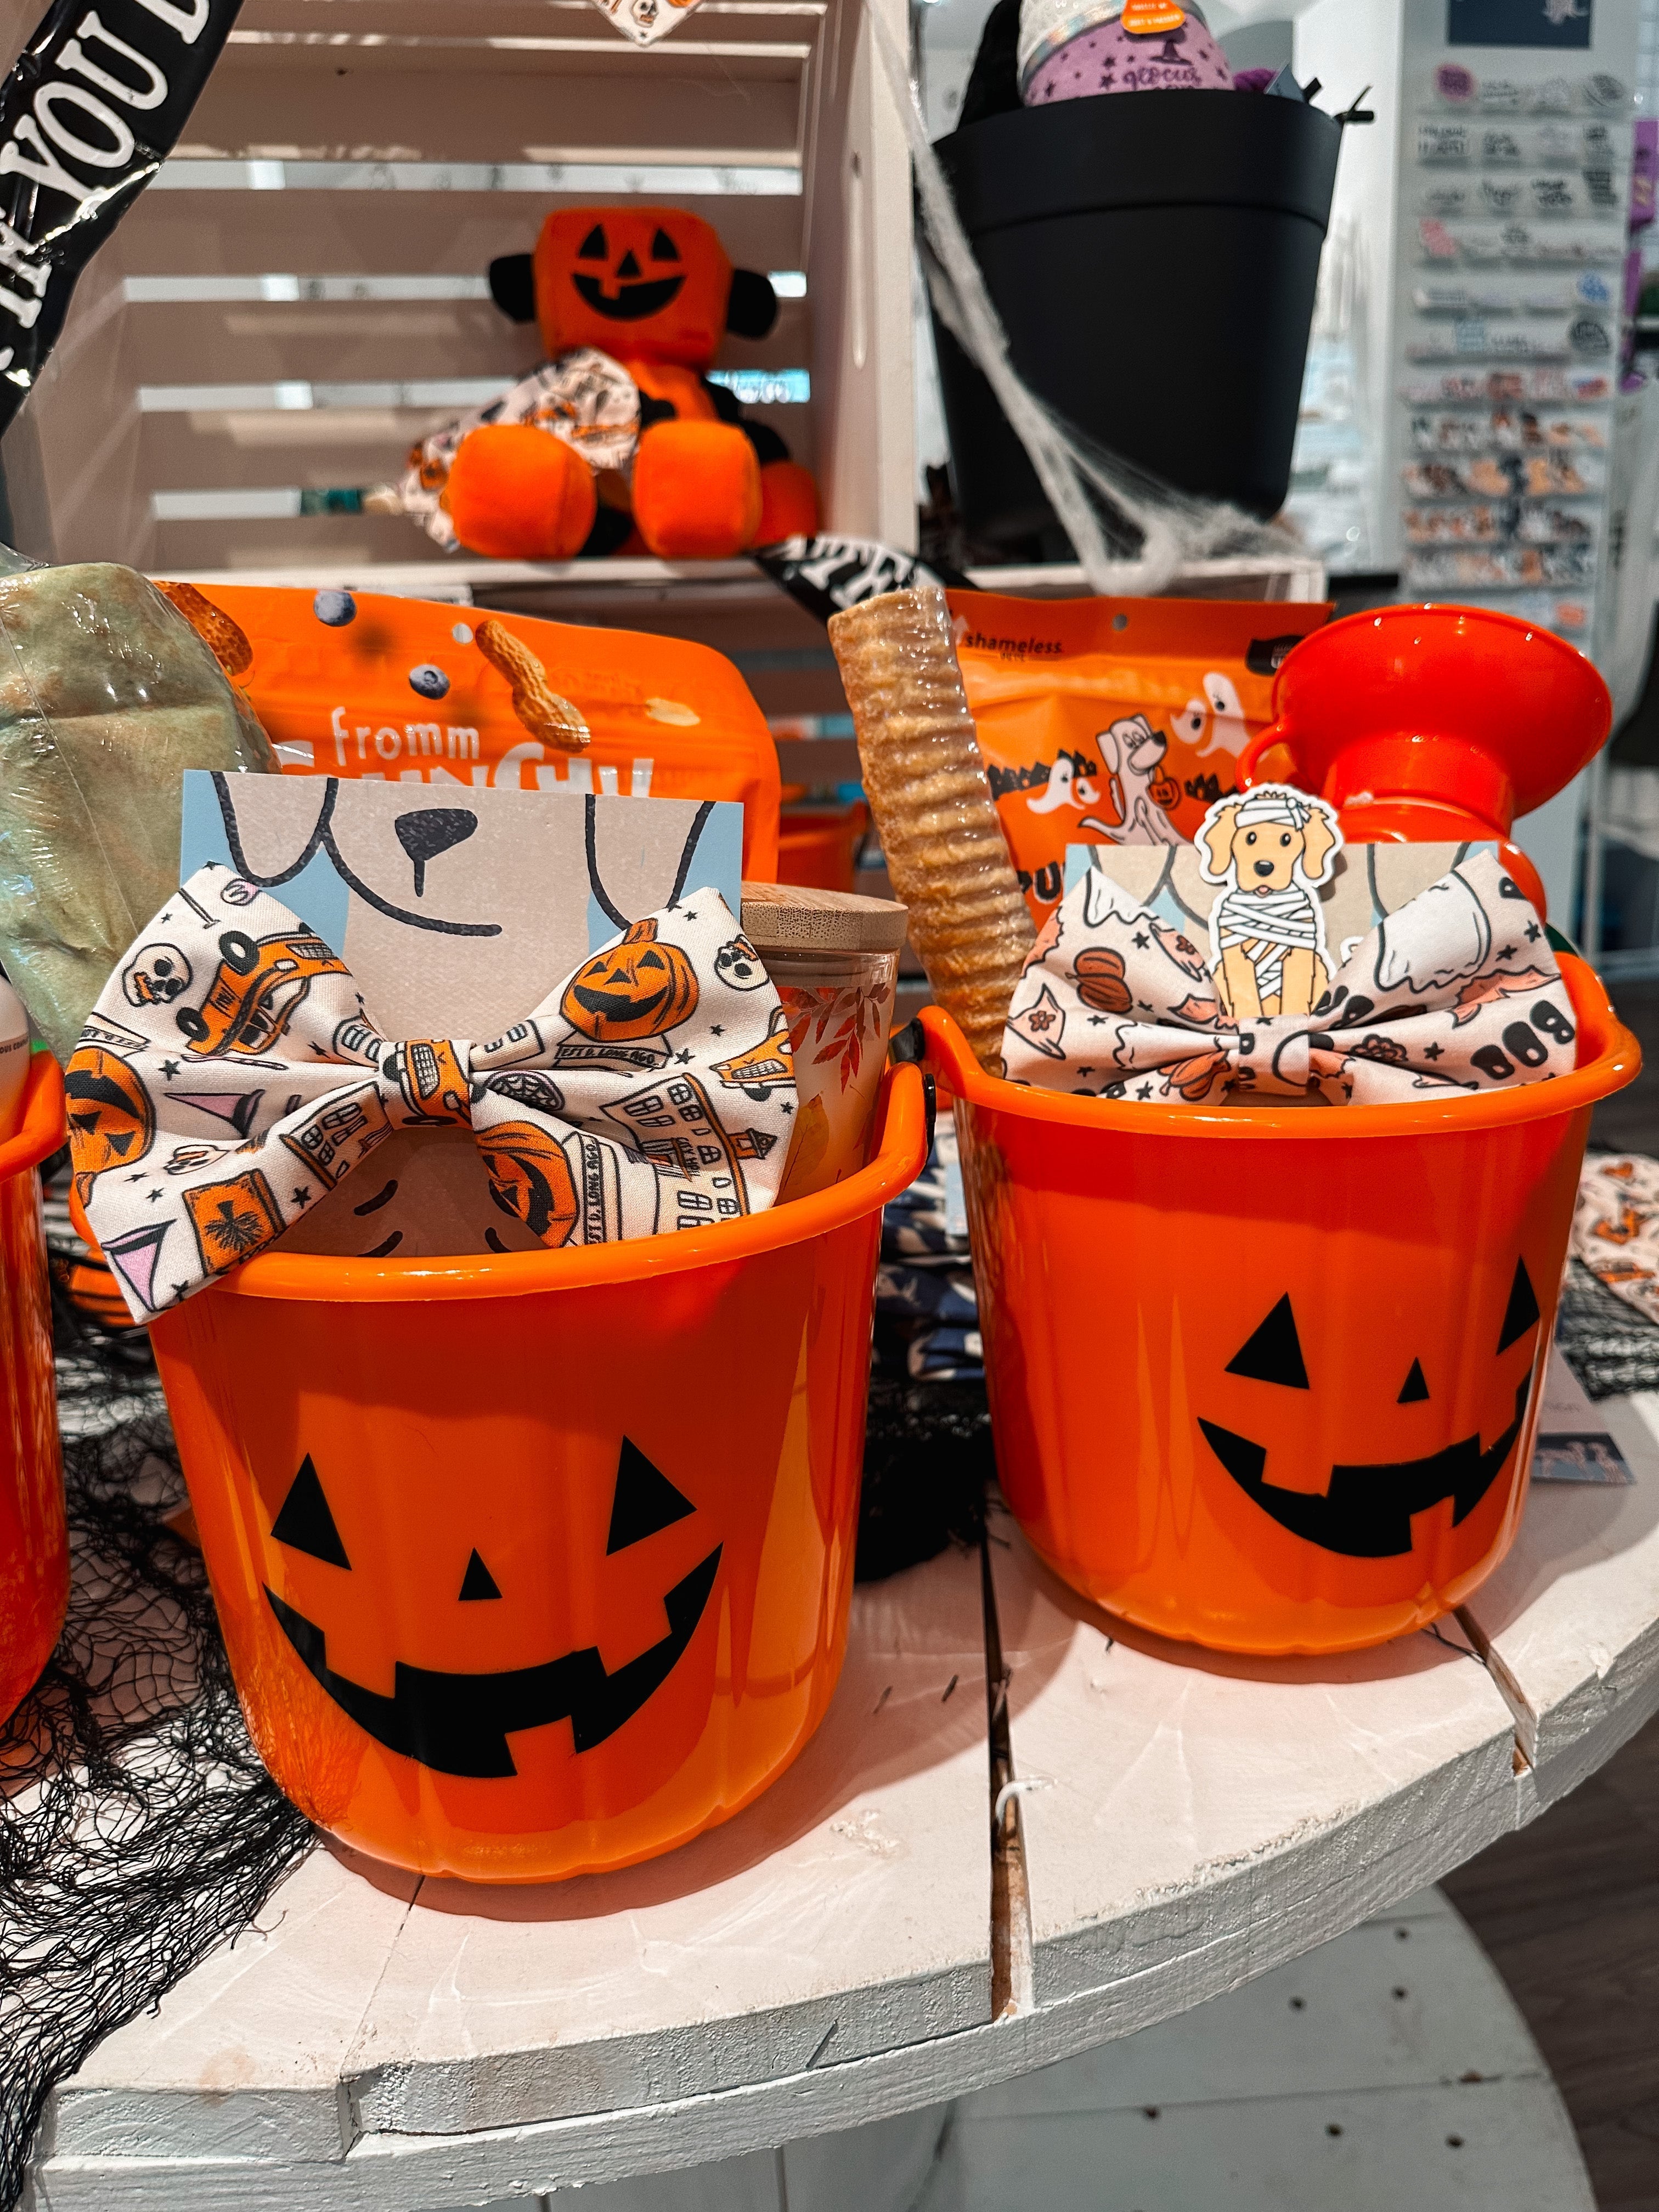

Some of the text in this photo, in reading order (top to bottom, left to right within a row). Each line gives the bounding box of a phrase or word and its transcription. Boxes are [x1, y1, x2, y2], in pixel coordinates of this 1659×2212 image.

[0, 11, 168, 219] YOU
[966, 633, 1063, 653] shameless
[331, 707, 479, 766] fromm
